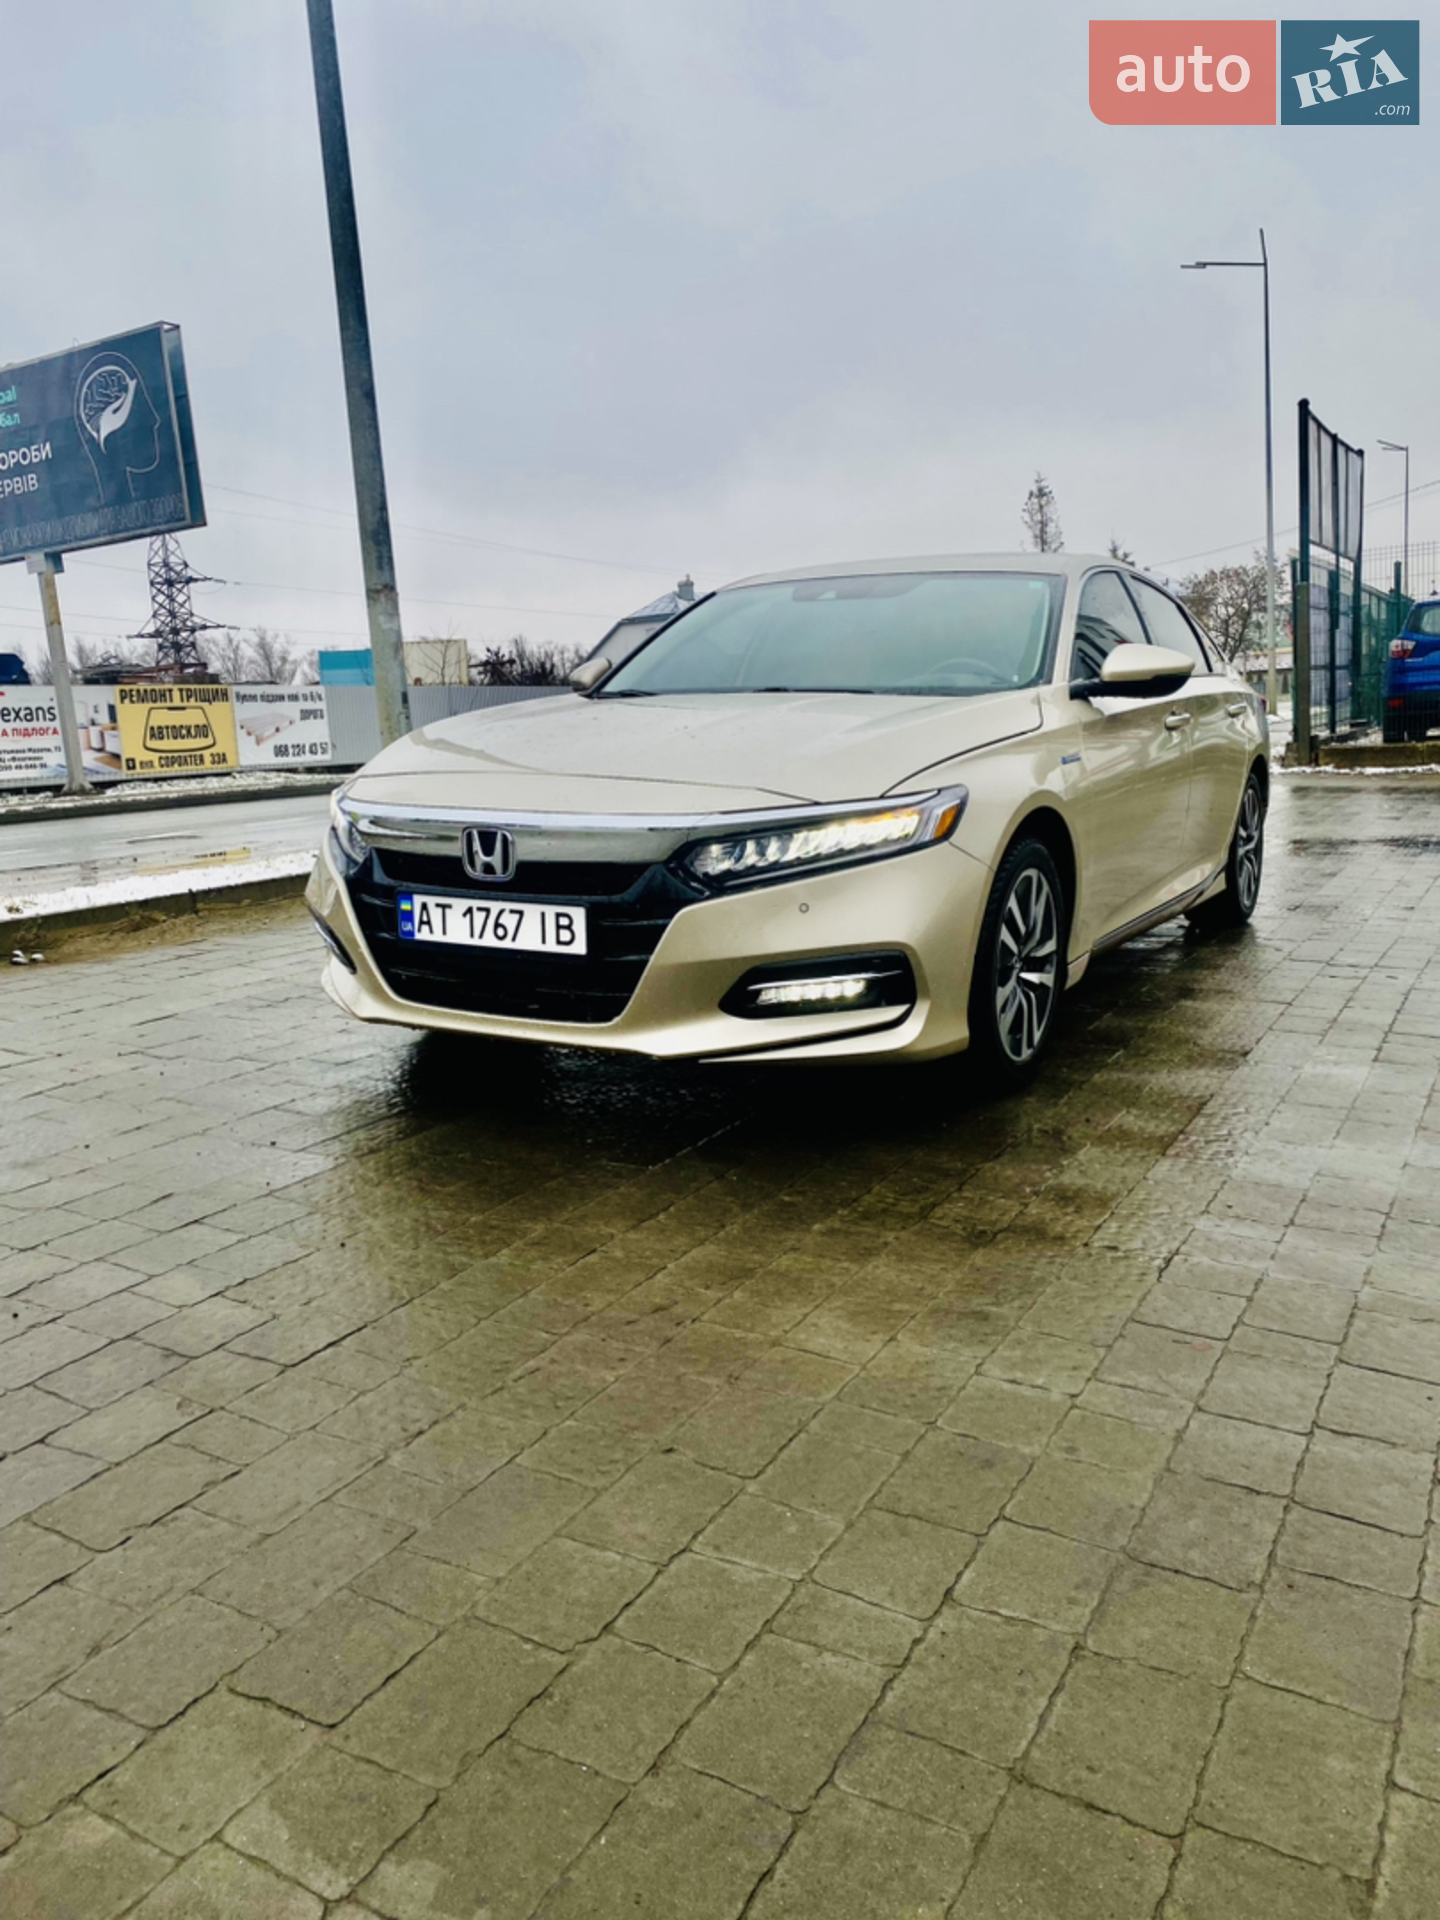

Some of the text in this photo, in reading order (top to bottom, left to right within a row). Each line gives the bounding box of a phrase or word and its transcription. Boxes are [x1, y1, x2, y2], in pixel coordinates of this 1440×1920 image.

[119, 687, 229, 705] РЕМОНТ ТРІЩИН
[12, 727, 59, 738] ПІДЛОГА
[149, 724, 209, 741] АВТОСКЛО
[158, 753, 205, 769] СОРОХТЕЯ
[209, 752, 228, 765] 33А
[401, 922, 413, 932] UA
[417, 901, 576, 946] AT 1767 IB
